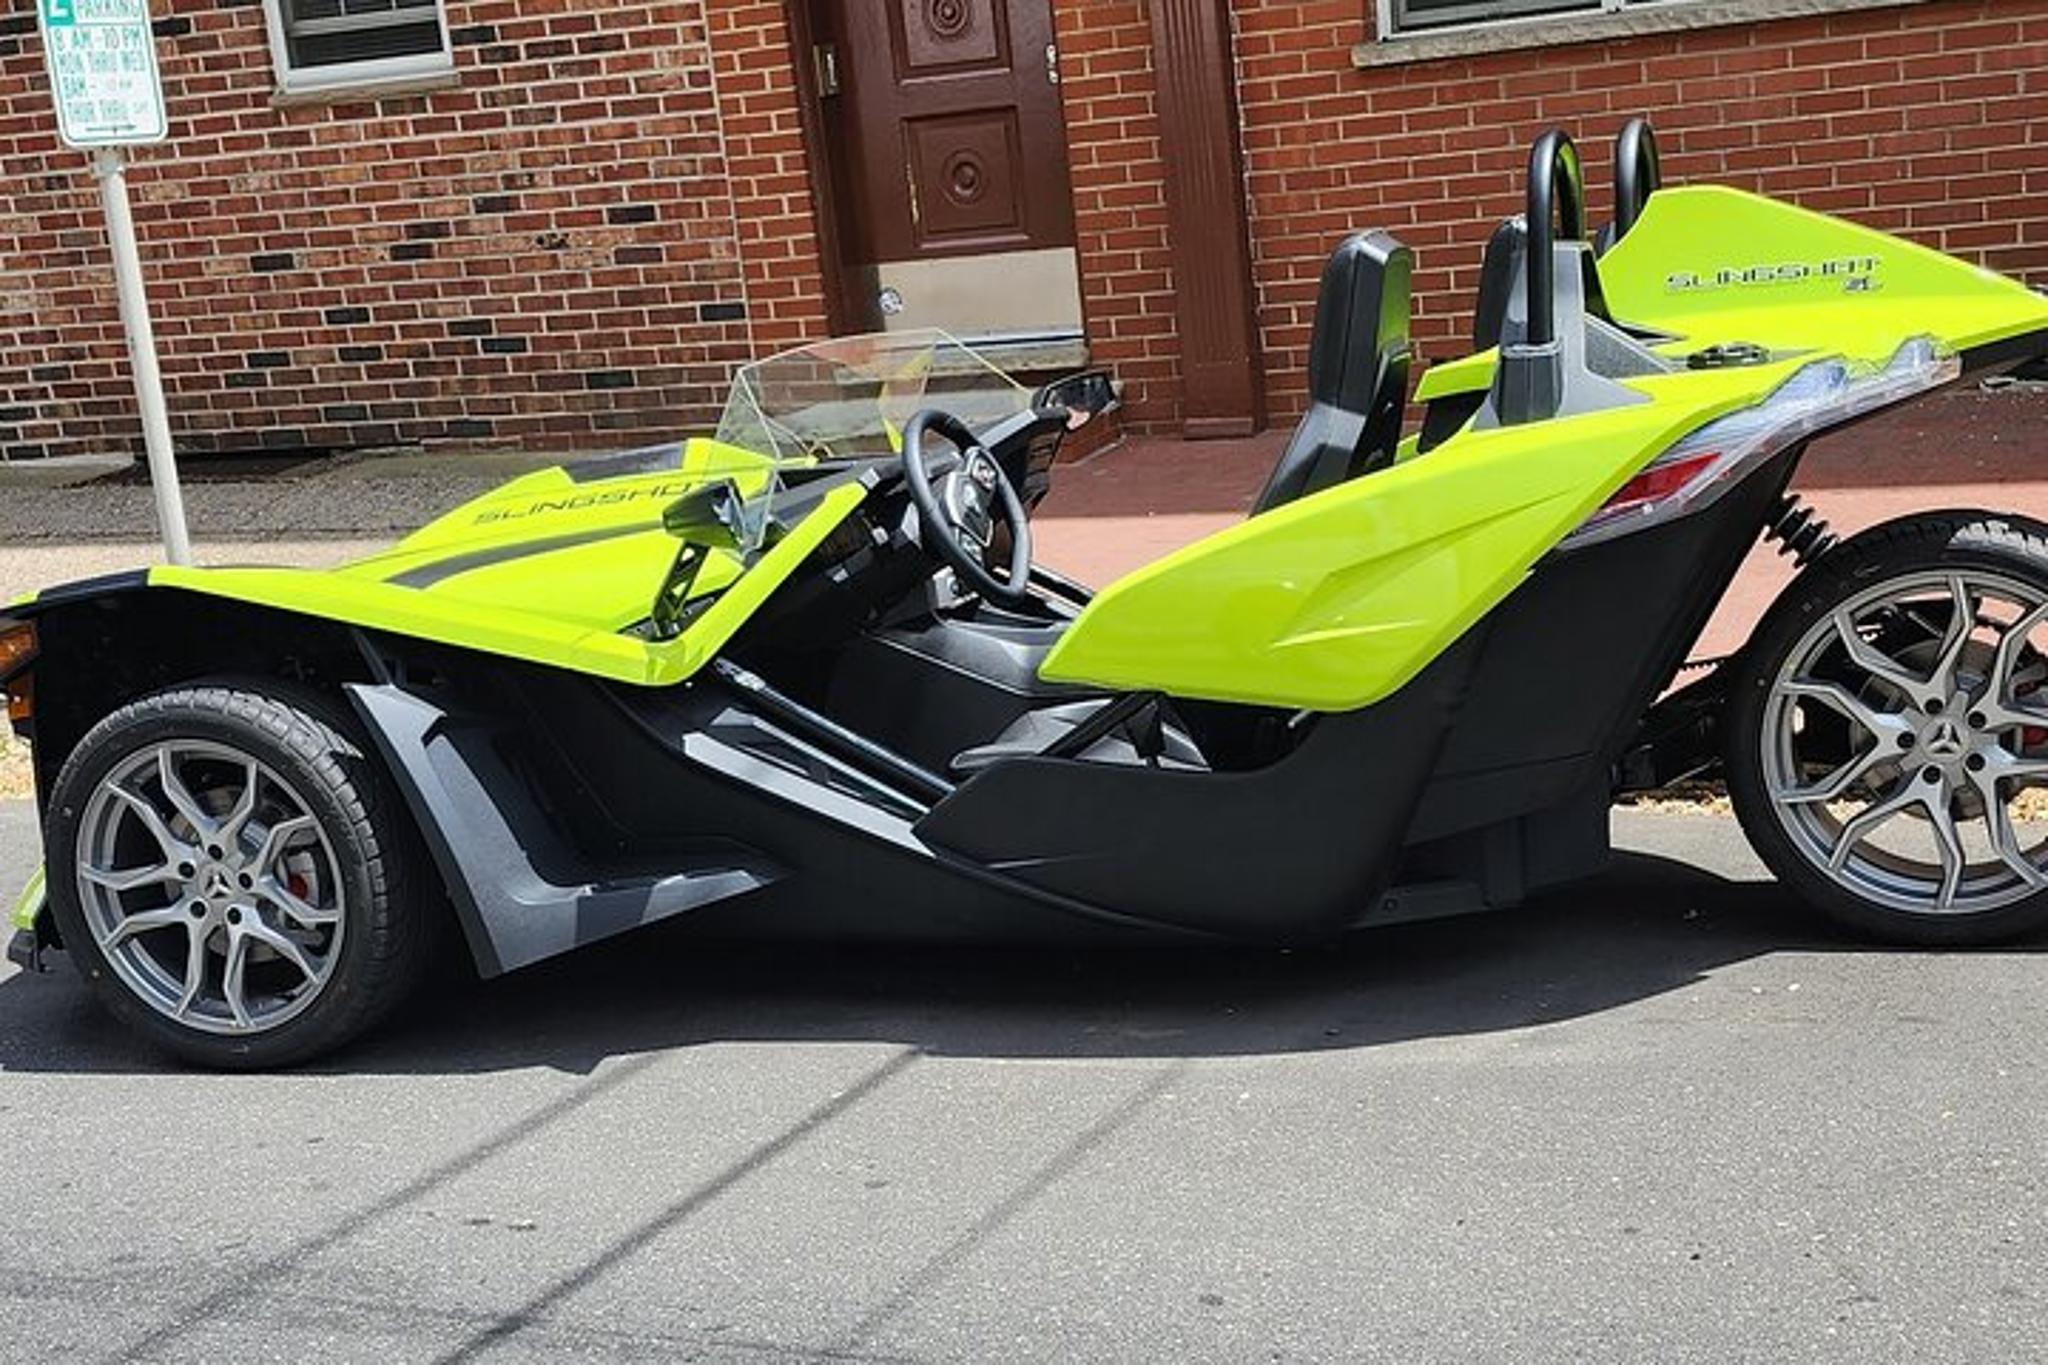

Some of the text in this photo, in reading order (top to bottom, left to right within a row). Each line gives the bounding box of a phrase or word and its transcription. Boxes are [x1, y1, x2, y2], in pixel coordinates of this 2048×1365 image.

[121, 26, 144, 48] PM
[1665, 256, 1882, 294] SLINGSHOT
[474, 480, 705, 524] SLINGSHO
